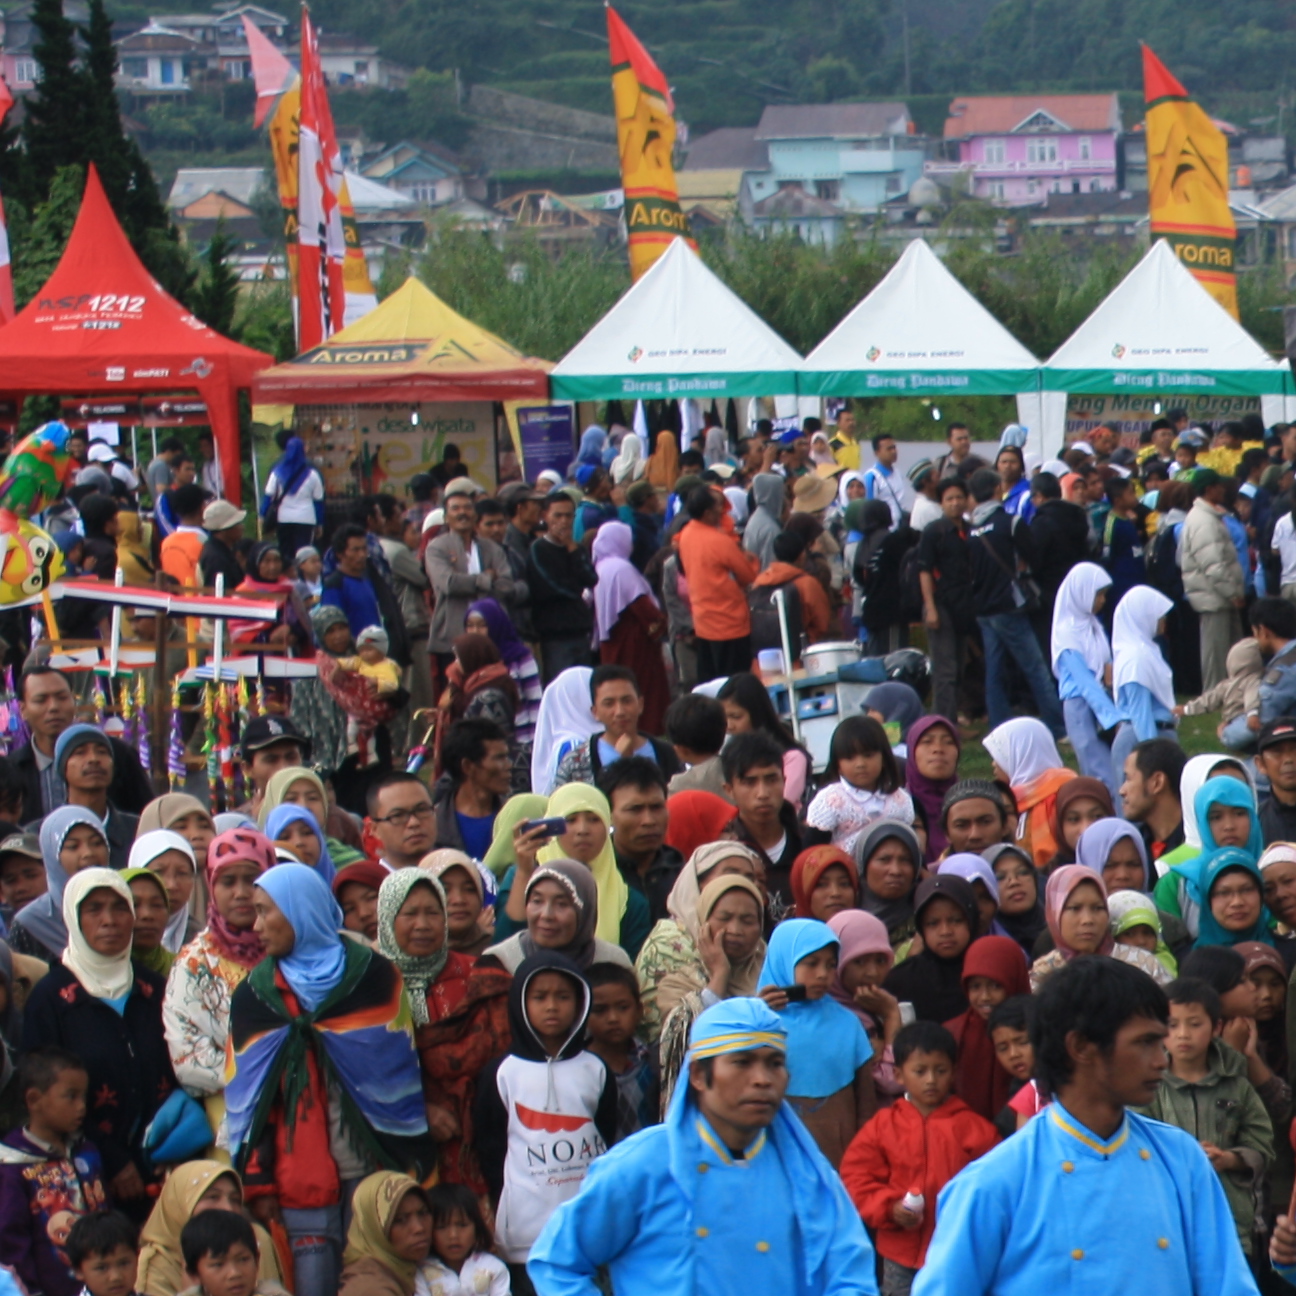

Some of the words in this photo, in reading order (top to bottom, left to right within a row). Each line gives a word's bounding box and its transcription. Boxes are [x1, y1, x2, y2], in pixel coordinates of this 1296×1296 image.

[1174, 243, 1232, 267] roma
[311, 346, 407, 365] Aroma
[421, 418, 476, 434] wisata
